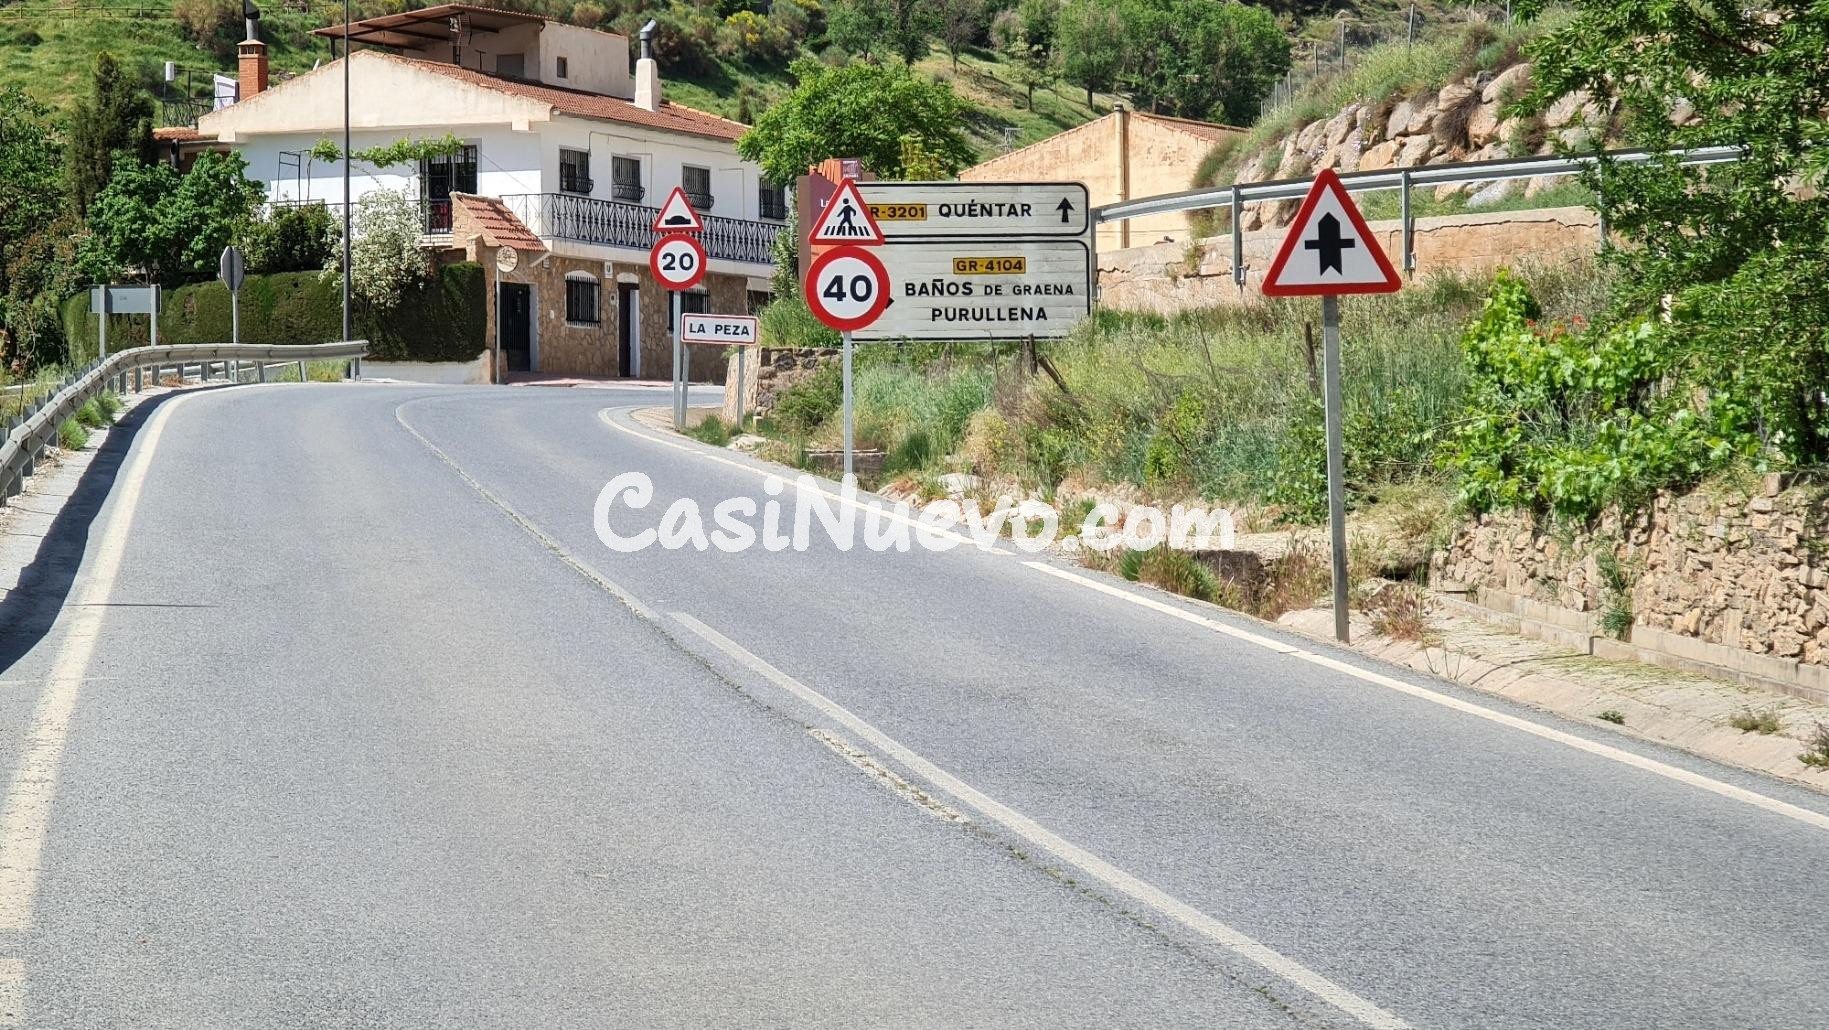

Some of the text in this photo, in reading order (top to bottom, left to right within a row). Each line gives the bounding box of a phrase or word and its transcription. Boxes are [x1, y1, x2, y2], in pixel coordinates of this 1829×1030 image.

[871, 199, 1032, 218] R-3201 QUÉNTAR
[662, 252, 694, 271] 20
[956, 260, 1023, 272] GR-4104
[823, 274, 873, 302] 40
[905, 278, 1074, 297] BAÑOS DE GRAENA
[931, 307, 1048, 322] PURULLENA
[689, 323, 750, 336] LA PEZA
